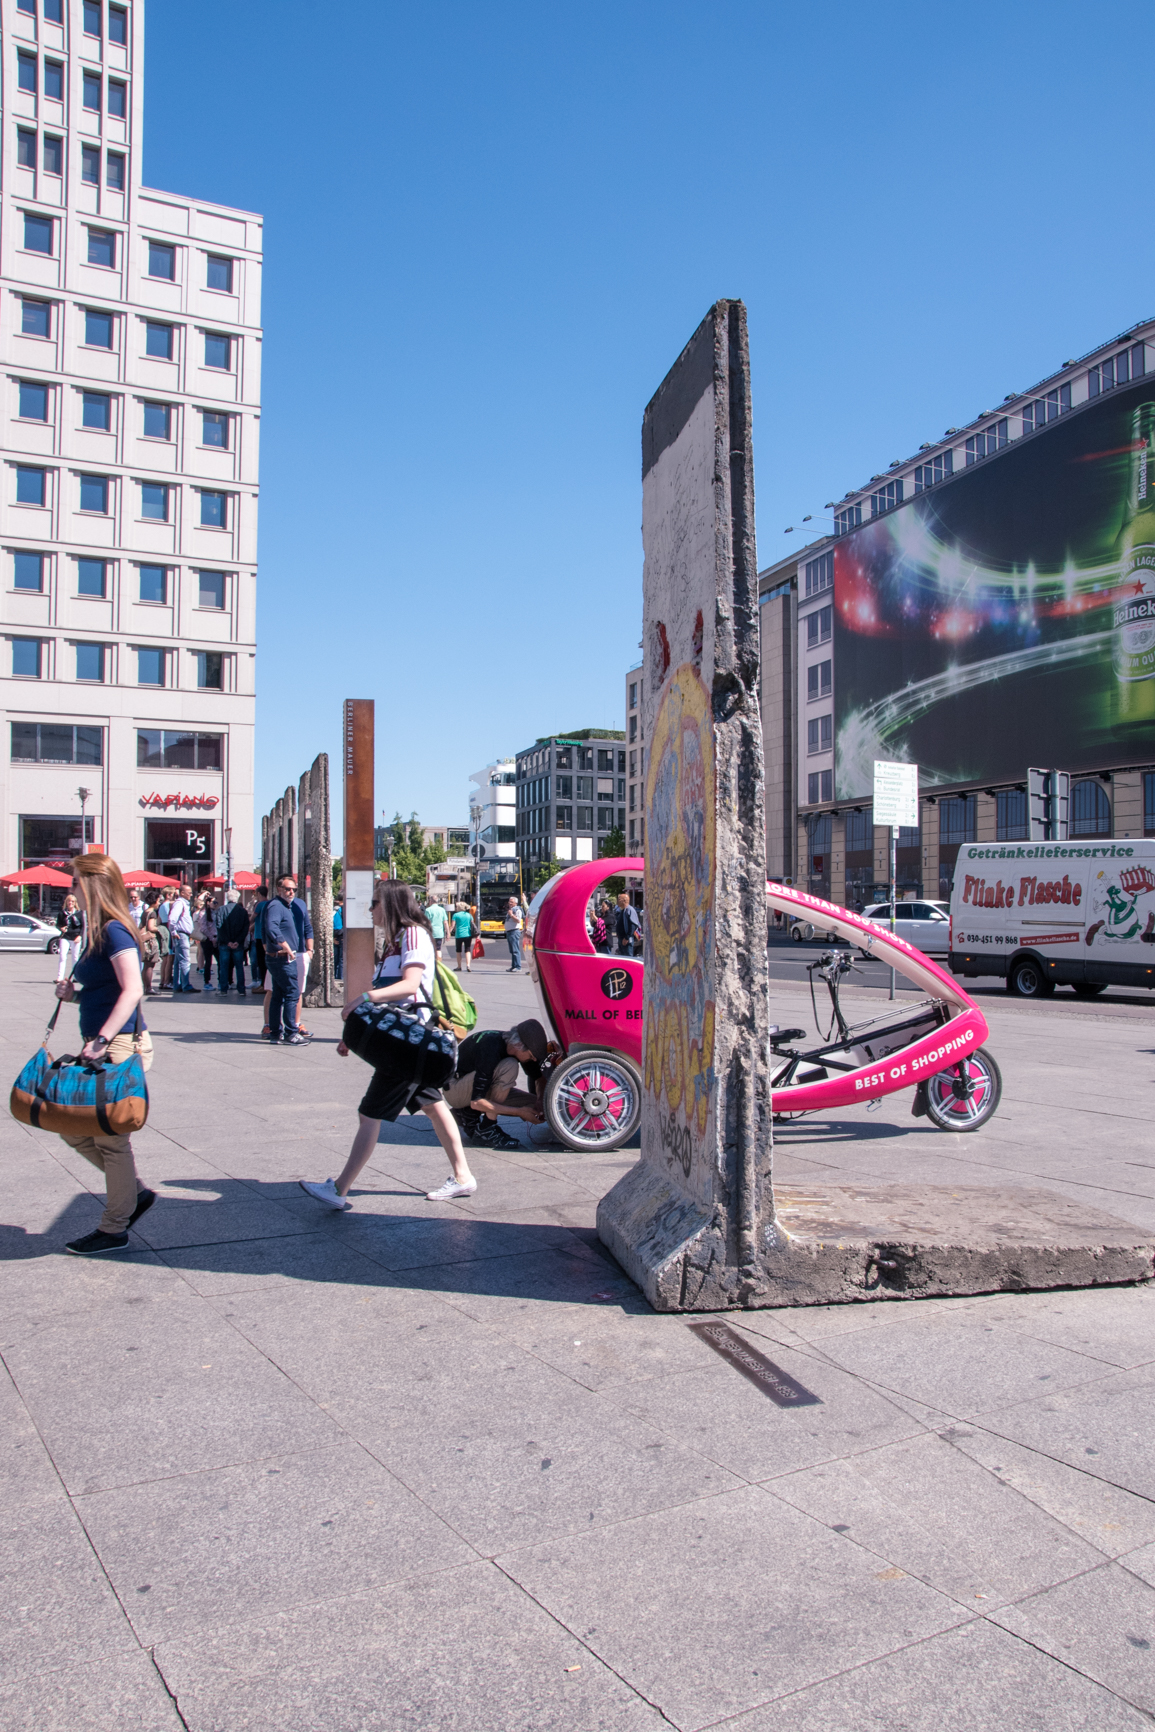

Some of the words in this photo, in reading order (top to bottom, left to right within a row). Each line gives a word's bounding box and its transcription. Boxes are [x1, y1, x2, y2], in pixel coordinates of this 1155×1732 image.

[1138, 451, 1147, 500] Heineken
[967, 845, 1134, 859] Getränkelieferservice
[962, 874, 1015, 908] Flinke
[1017, 874, 1082, 906] Flasche
[803, 892, 841, 914] THAN
[845, 910, 871, 926] 300
[873, 923, 913, 951] SHOPS
[967, 934, 993, 944] 030-451
[995, 936, 1004, 944] 99
[1005, 935, 1018, 945] 868
[564, 1009, 597, 1020] MALL
[602, 1009, 619, 1020] OF
[855, 1072, 885, 1090] BEST
[890, 1064, 907, 1079] OF
[911, 1029, 974, 1071] SHOPPING
